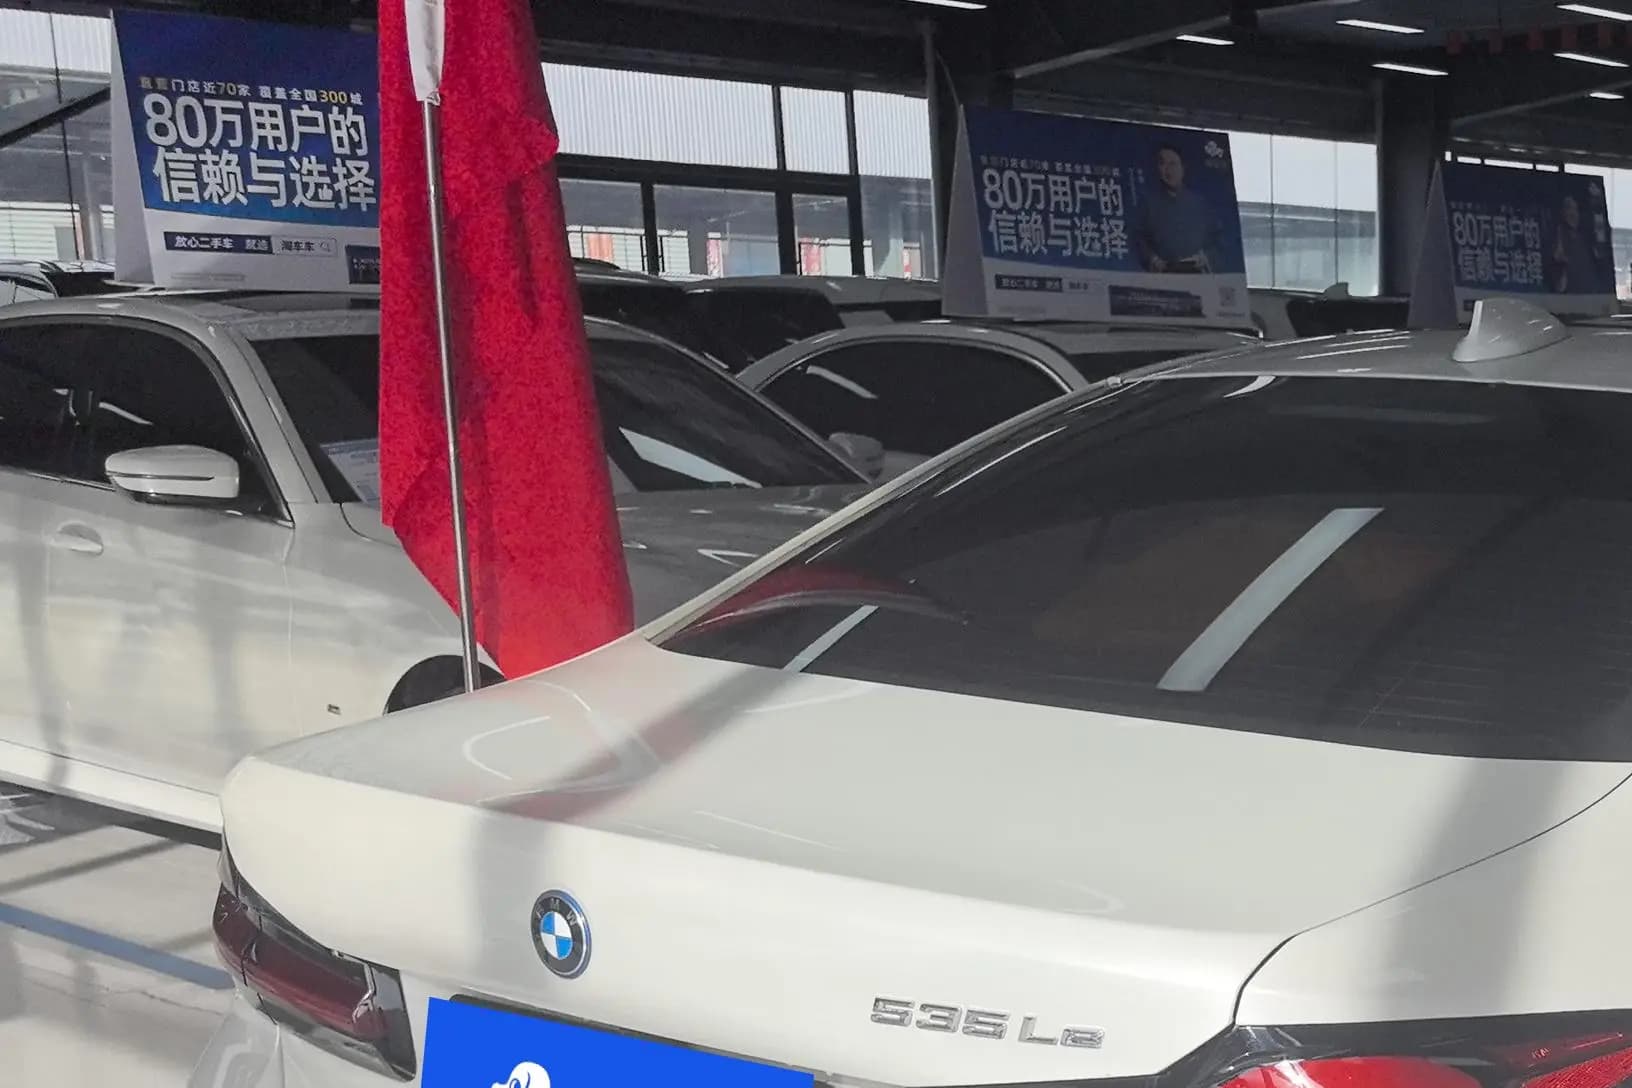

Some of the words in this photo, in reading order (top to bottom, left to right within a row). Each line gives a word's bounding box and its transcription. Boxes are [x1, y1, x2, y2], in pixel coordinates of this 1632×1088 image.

[144, 93, 368, 156] 80万用户的
[153, 146, 376, 212] 信赖与选择
[983, 168, 1124, 216] 80万用户的
[989, 211, 1129, 260] 信赖与选择
[1453, 211, 1541, 249] 80万用户的
